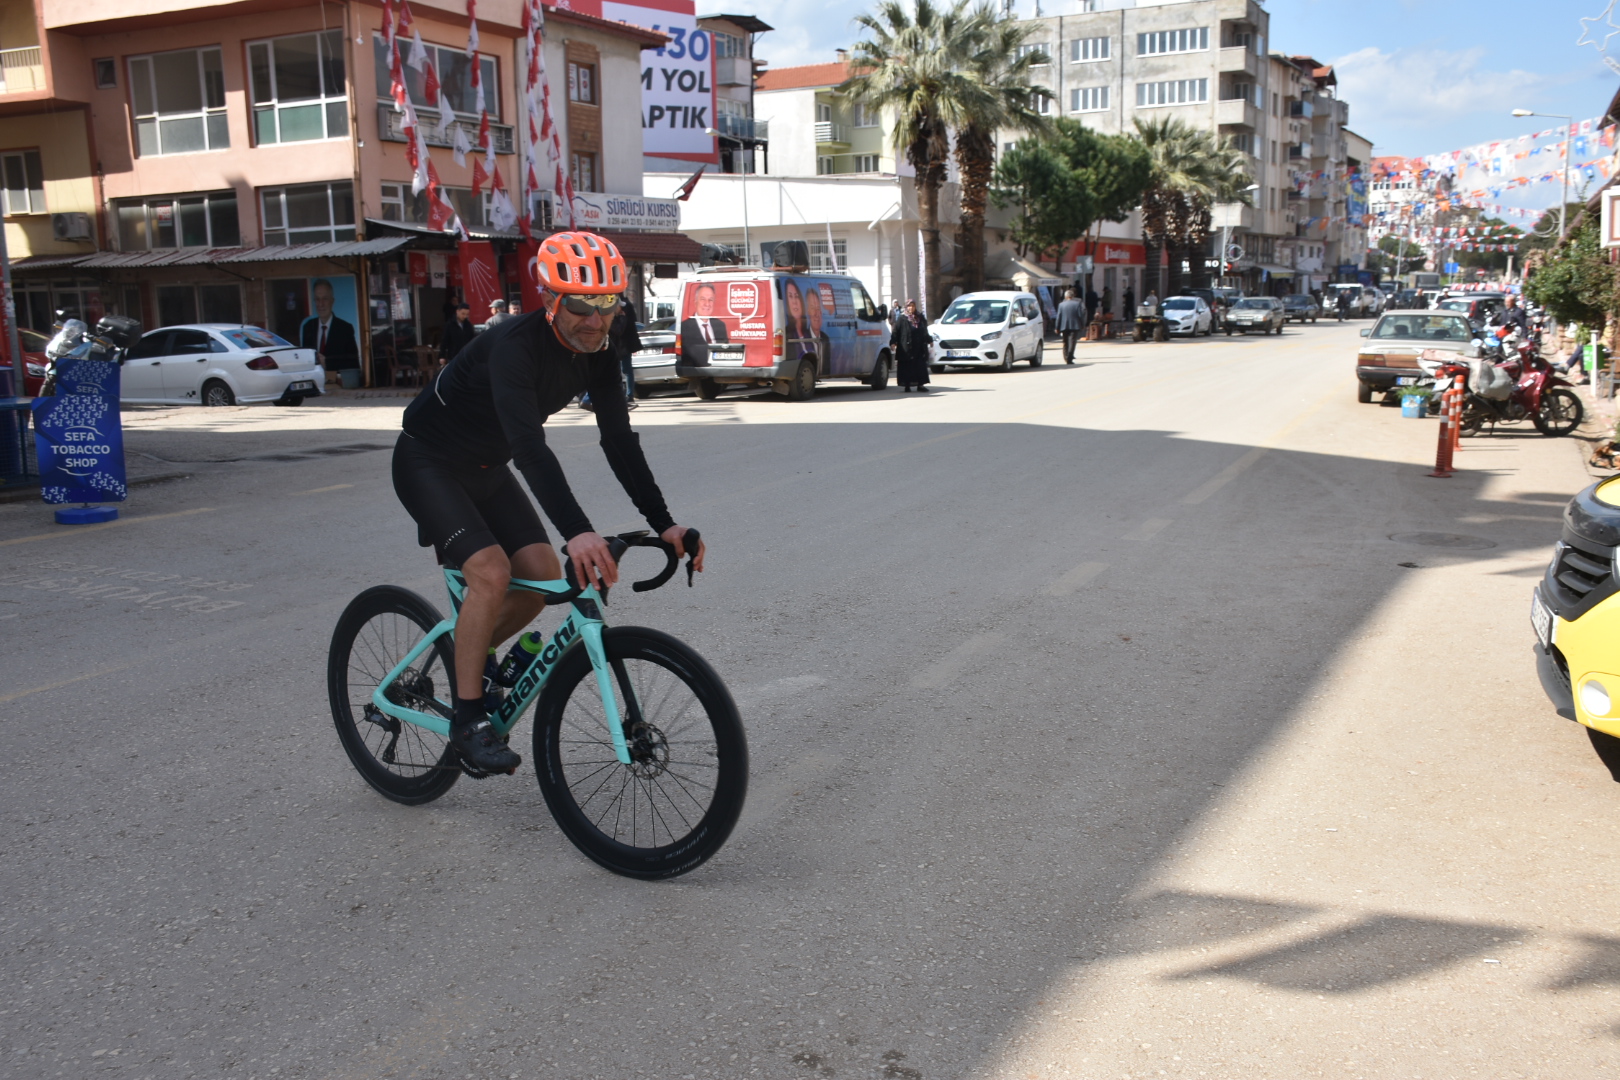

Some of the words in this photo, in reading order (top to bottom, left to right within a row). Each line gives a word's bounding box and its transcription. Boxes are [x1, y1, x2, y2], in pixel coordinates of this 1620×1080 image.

[660, 68, 711, 93] YOL
[606, 198, 645, 216] SÜRÜCÜ
[647, 203, 677, 218] KURSU
[76, 385, 99, 394] SEFA
[64, 432, 95, 441] SEFA
[51, 445, 110, 454] TOBACCO
[65, 458, 98, 467] SHOP
[498, 614, 577, 724] Bianchi
